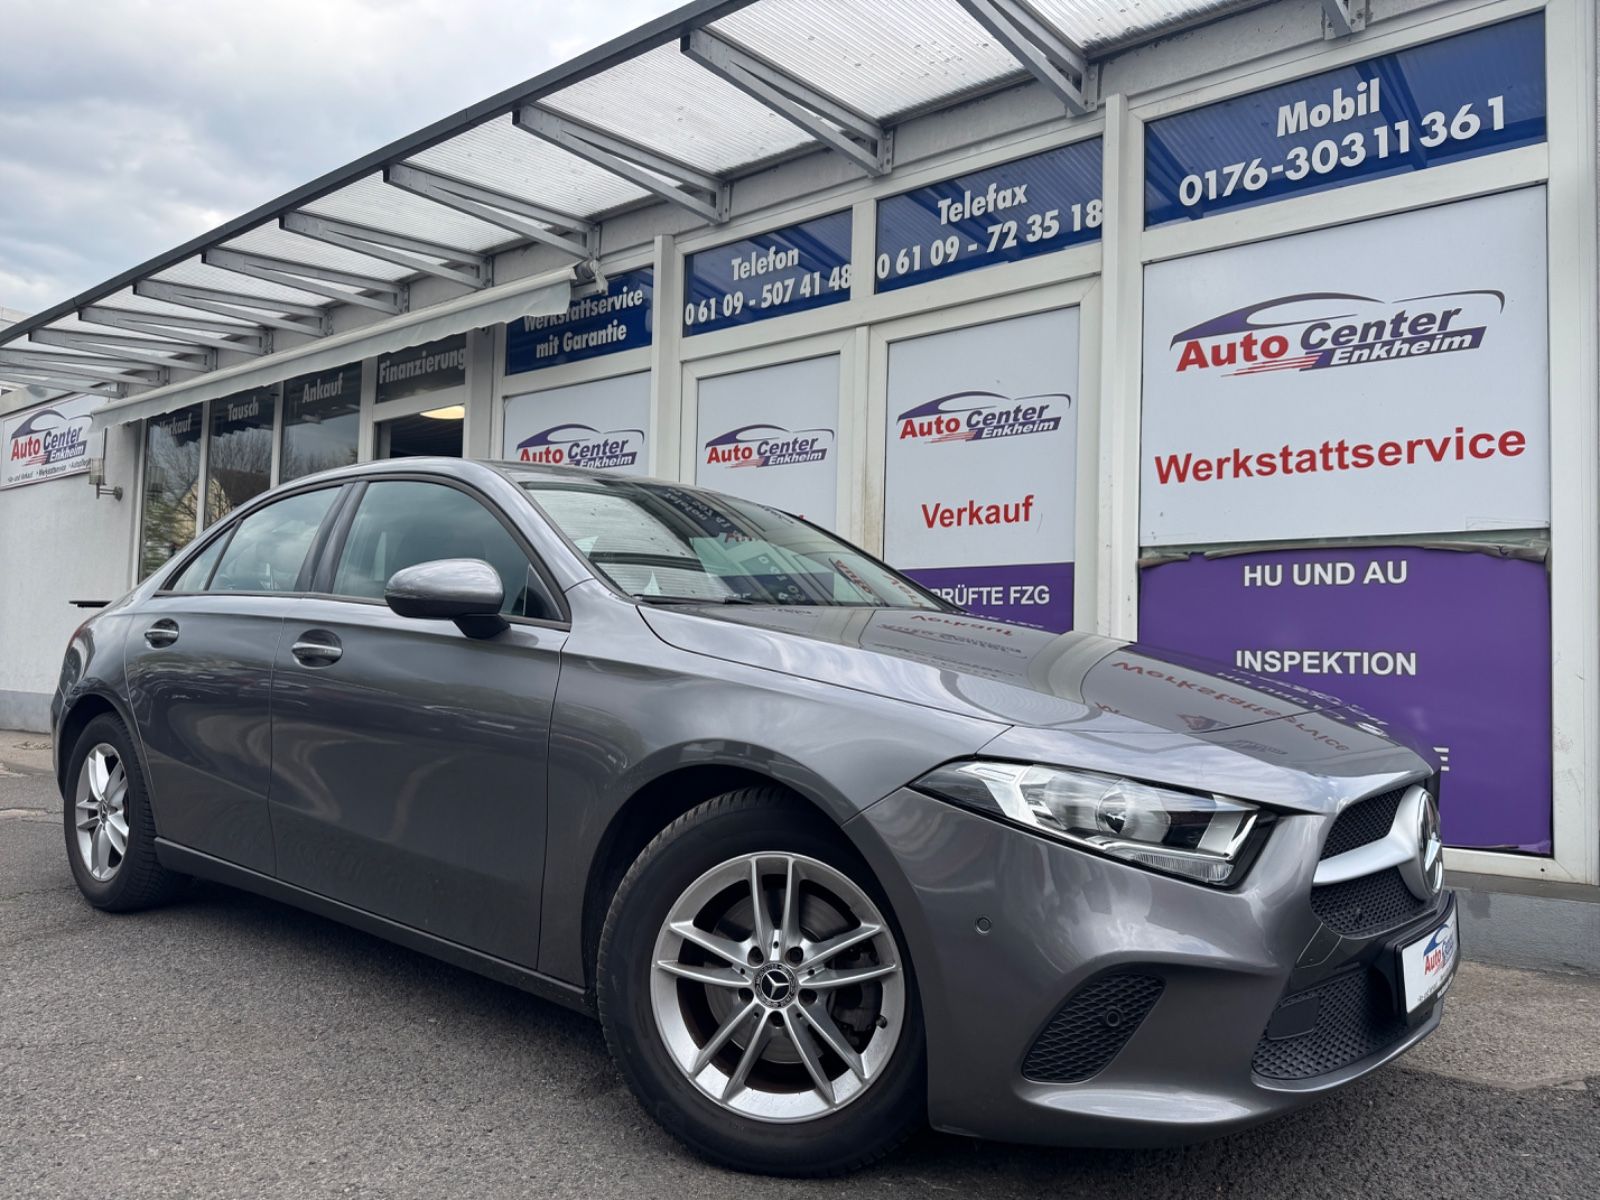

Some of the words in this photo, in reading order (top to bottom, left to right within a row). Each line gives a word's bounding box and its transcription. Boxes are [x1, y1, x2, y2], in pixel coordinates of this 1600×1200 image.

[1276, 77, 1381, 138] Mobil
[937, 183, 1028, 225] Telefax
[930, 236, 960, 266] 09
[986, 221, 1018, 253] 72
[1026, 209, 1060, 243] 35
[1071, 199, 1103, 232] 18
[731, 246, 799, 281] Telefon
[722, 291, 744, 317] 09
[760, 277, 795, 308] 507
[799, 271, 821, 298] 41
[828, 263, 852, 291] 48
[536, 335, 560, 358] mit
[563, 319, 627, 353] Garantie
[1176, 332, 1289, 372] Auto
[1300, 307, 1463, 351] Center
[1330, 332, 1472, 366] Enkheim
[378, 347, 466, 385] Finanzierung
[302, 371, 344, 403] Ankauf
[227, 396, 260, 422] Tausch
[900, 416, 961, 439] Auto
[966, 404, 1050, 428] Center
[11, 436, 41, 461] Auto
[43, 426, 83, 451] Center
[981, 420, 1055, 439] Enkheim
[51, 444, 84, 460] Enkheim
[520, 446, 564, 464] Auto
[567, 439, 629, 459] Center
[580, 454, 632, 469] Enkheim
[707, 443, 753, 464] Auto
[757, 437, 819, 456] Center
[768, 451, 823, 466] Enkheim
[1155, 427, 1526, 484] Werkstattservice
[921, 494, 1034, 528] Verkauf
[1243, 564, 1283, 587] HU
[1292, 562, 1356, 586] UND
[1362, 560, 1408, 585] AU
[1010, 585, 1050, 605] FZG
[1236, 650, 1416, 676] INSPEKTION
